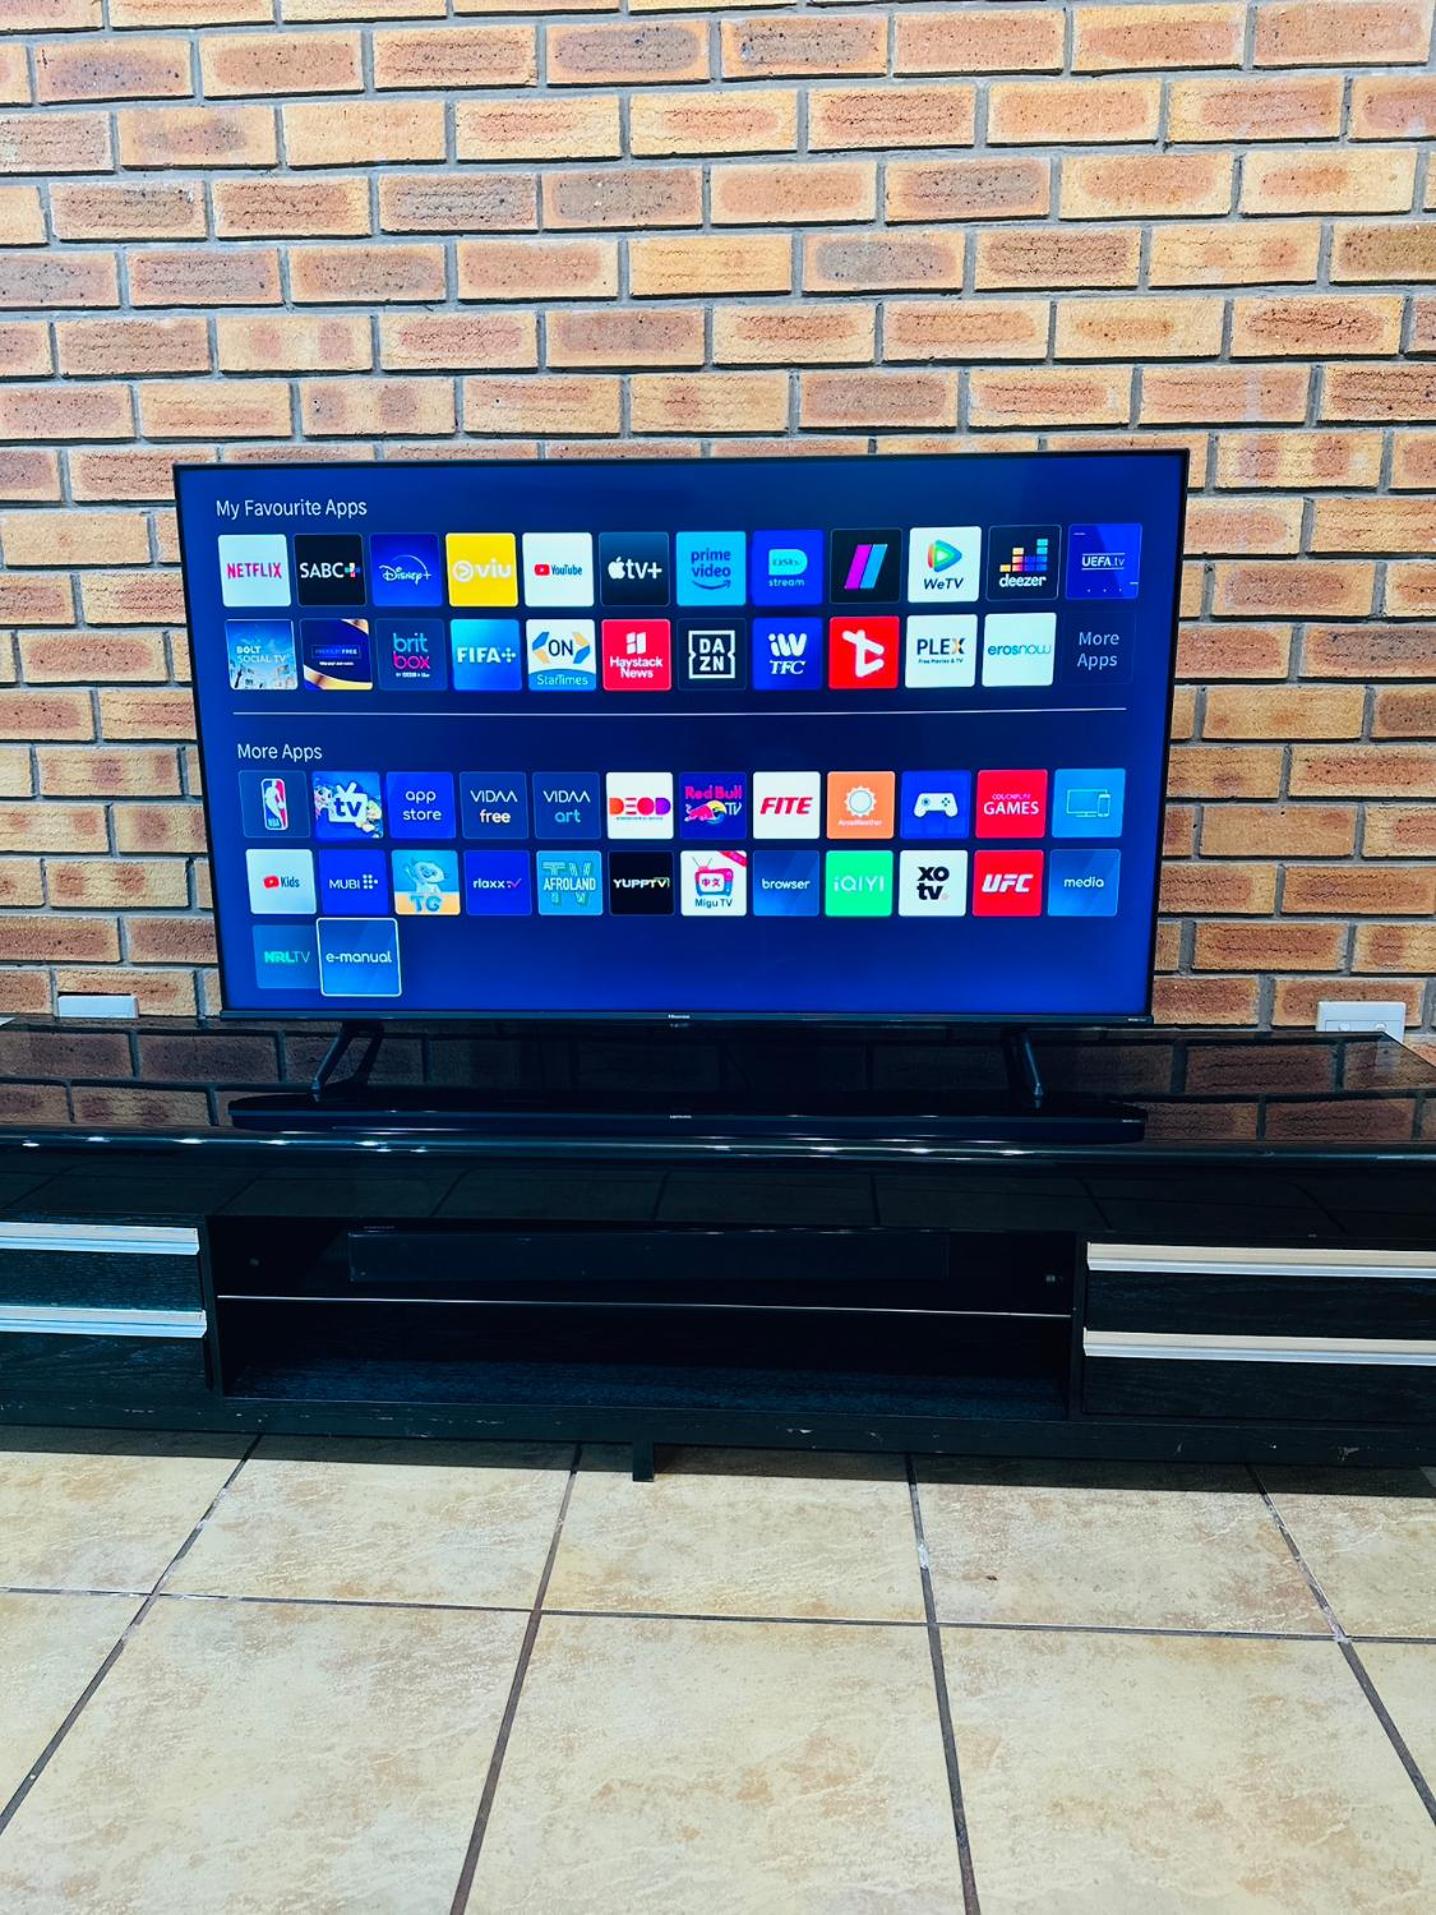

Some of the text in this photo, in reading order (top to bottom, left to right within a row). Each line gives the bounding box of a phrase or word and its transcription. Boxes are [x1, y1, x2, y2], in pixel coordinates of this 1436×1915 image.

[216, 500, 367, 520] My Favourite Apps
[691, 547, 731, 562] prime
[227, 562, 282, 579] NETFLIX
[474, 559, 512, 578] viu
[551, 563, 583, 576] YouTube
[628, 558, 663, 579] tv+
[692, 565, 731, 578] video
[769, 578, 805, 587] stream
[923, 578, 964, 590] WeTV
[999, 573, 1047, 588] deezer
[393, 632, 429, 653] brit
[1078, 631, 1120, 647] More
[236, 645, 261, 654] BOLT
[549, 639, 573, 656] ON
[917, 638, 965, 655] PLEX
[987, 643, 1051, 655] erosnow
[237, 654, 287, 663] SOCIAL TV
[392, 652, 431, 670] box
[457, 647, 516, 663] FIFA+
[609, 655, 663, 668] Haystack
[1077, 653, 1118, 670] Apps
[620, 666, 654, 678] News
[769, 660, 806, 675] TFC
[536, 674, 589, 686] StarTimes
[237, 743, 323, 762] More Apps
[405, 790, 436, 803] app
[685, 785, 742, 800] Red Bull
[334, 797, 362, 817] tv
[726, 802, 742, 815] TV
[760, 797, 813, 814] FITE
[983, 801, 1040, 815] GAMES
[403, 808, 442, 821] store
[480, 809, 511, 823] free
[554, 808, 581, 823] art
[918, 866, 950, 882] xo
[281, 876, 300, 888] Kids
[329, 880, 360, 889] MUBI
[543, 877, 596, 891] AFROLAND
[613, 877, 669, 888] YUPPTV
[762, 878, 810, 890] browser
[981, 874, 1034, 893] UFC
[1064, 877, 1104, 888] media
[917, 883, 943, 900] tv
[410, 895, 442, 912] TG
[695, 899, 732, 908] Migu TV
[326, 951, 392, 963] e-manual
